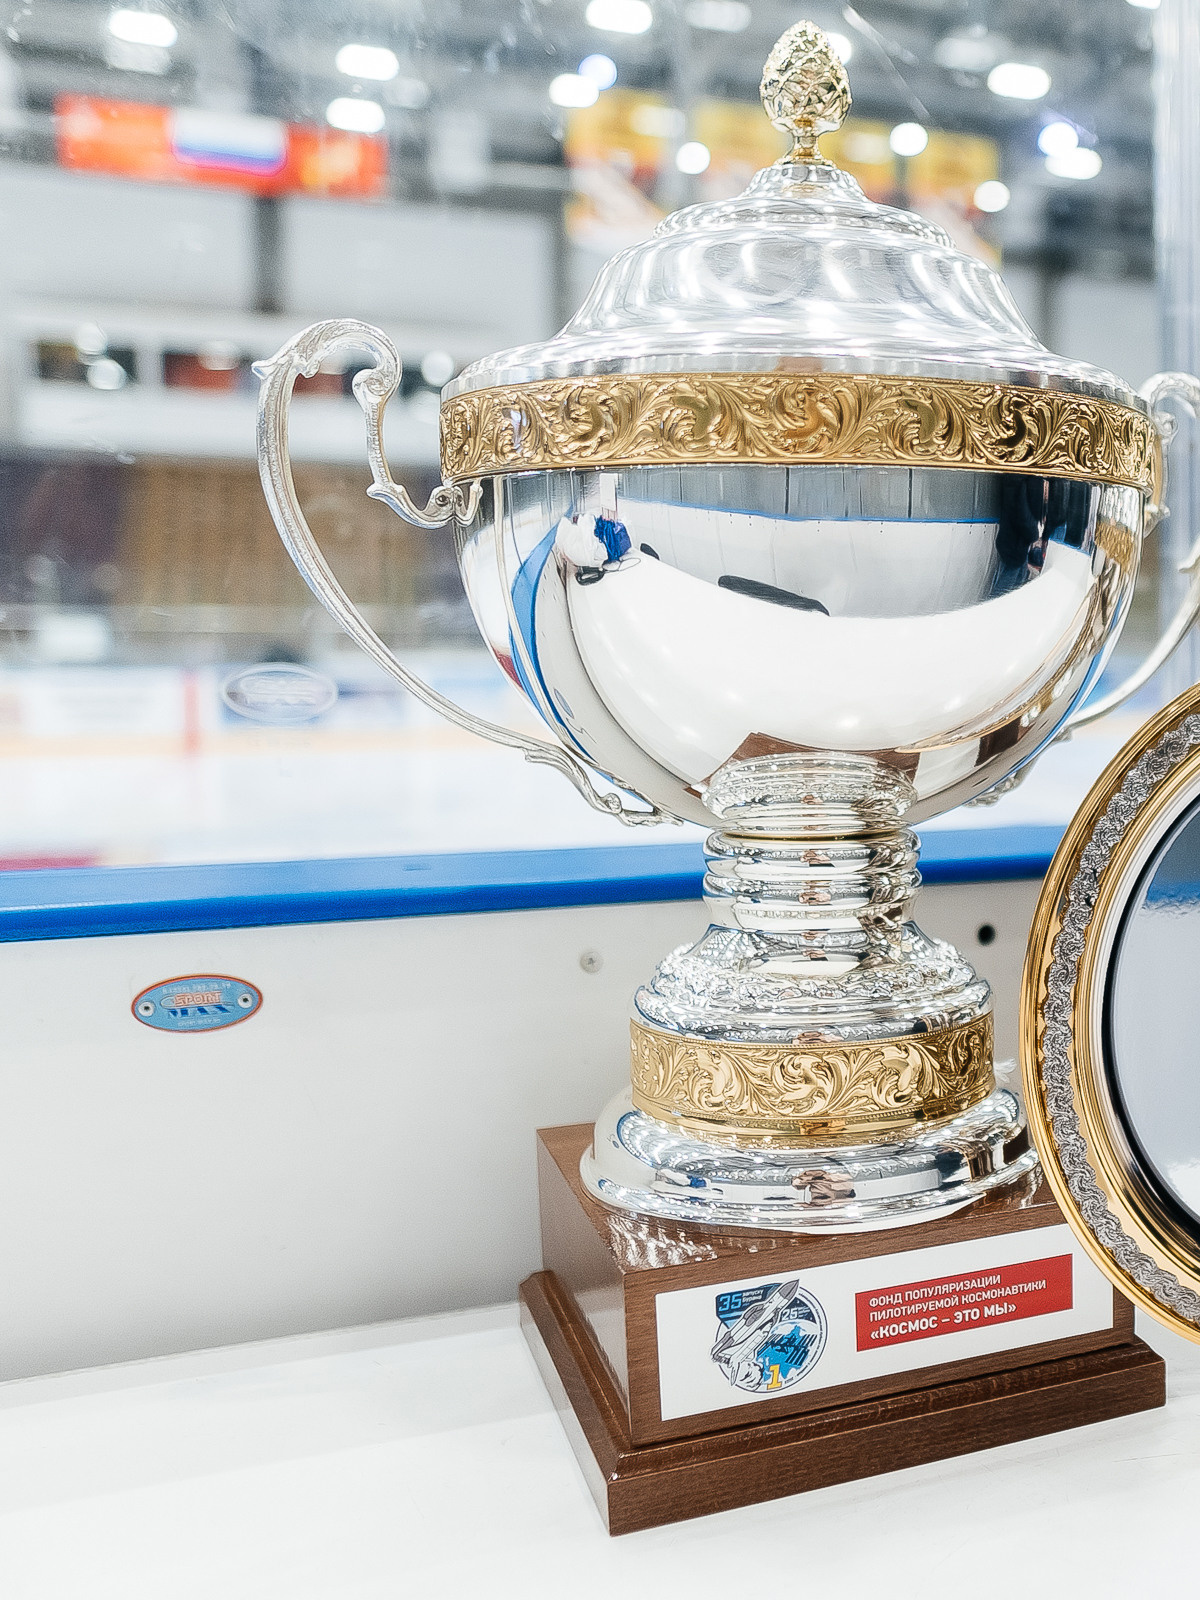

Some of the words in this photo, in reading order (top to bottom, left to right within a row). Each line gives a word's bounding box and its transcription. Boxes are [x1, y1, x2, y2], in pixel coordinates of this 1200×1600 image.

[174, 991, 223, 1007] SPORT
[718, 1293, 742, 1312] 35
[869, 1293, 903, 1308] ФОНД
[905, 1274, 1001, 1301] ПОПУЛЯРИЗАЦИИ
[869, 1295, 959, 1322] ПИЛОТИРУЕМОЙ
[961, 1279, 1046, 1304] КОСМОНАВТИКИ
[781, 1308, 798, 1321] 25
[870, 1316, 938, 1340] «КОСМОС
[953, 1308, 980, 1324] ЭТО
[984, 1302, 1017, 1317] МЫ»
[766, 1364, 782, 1390] 1
